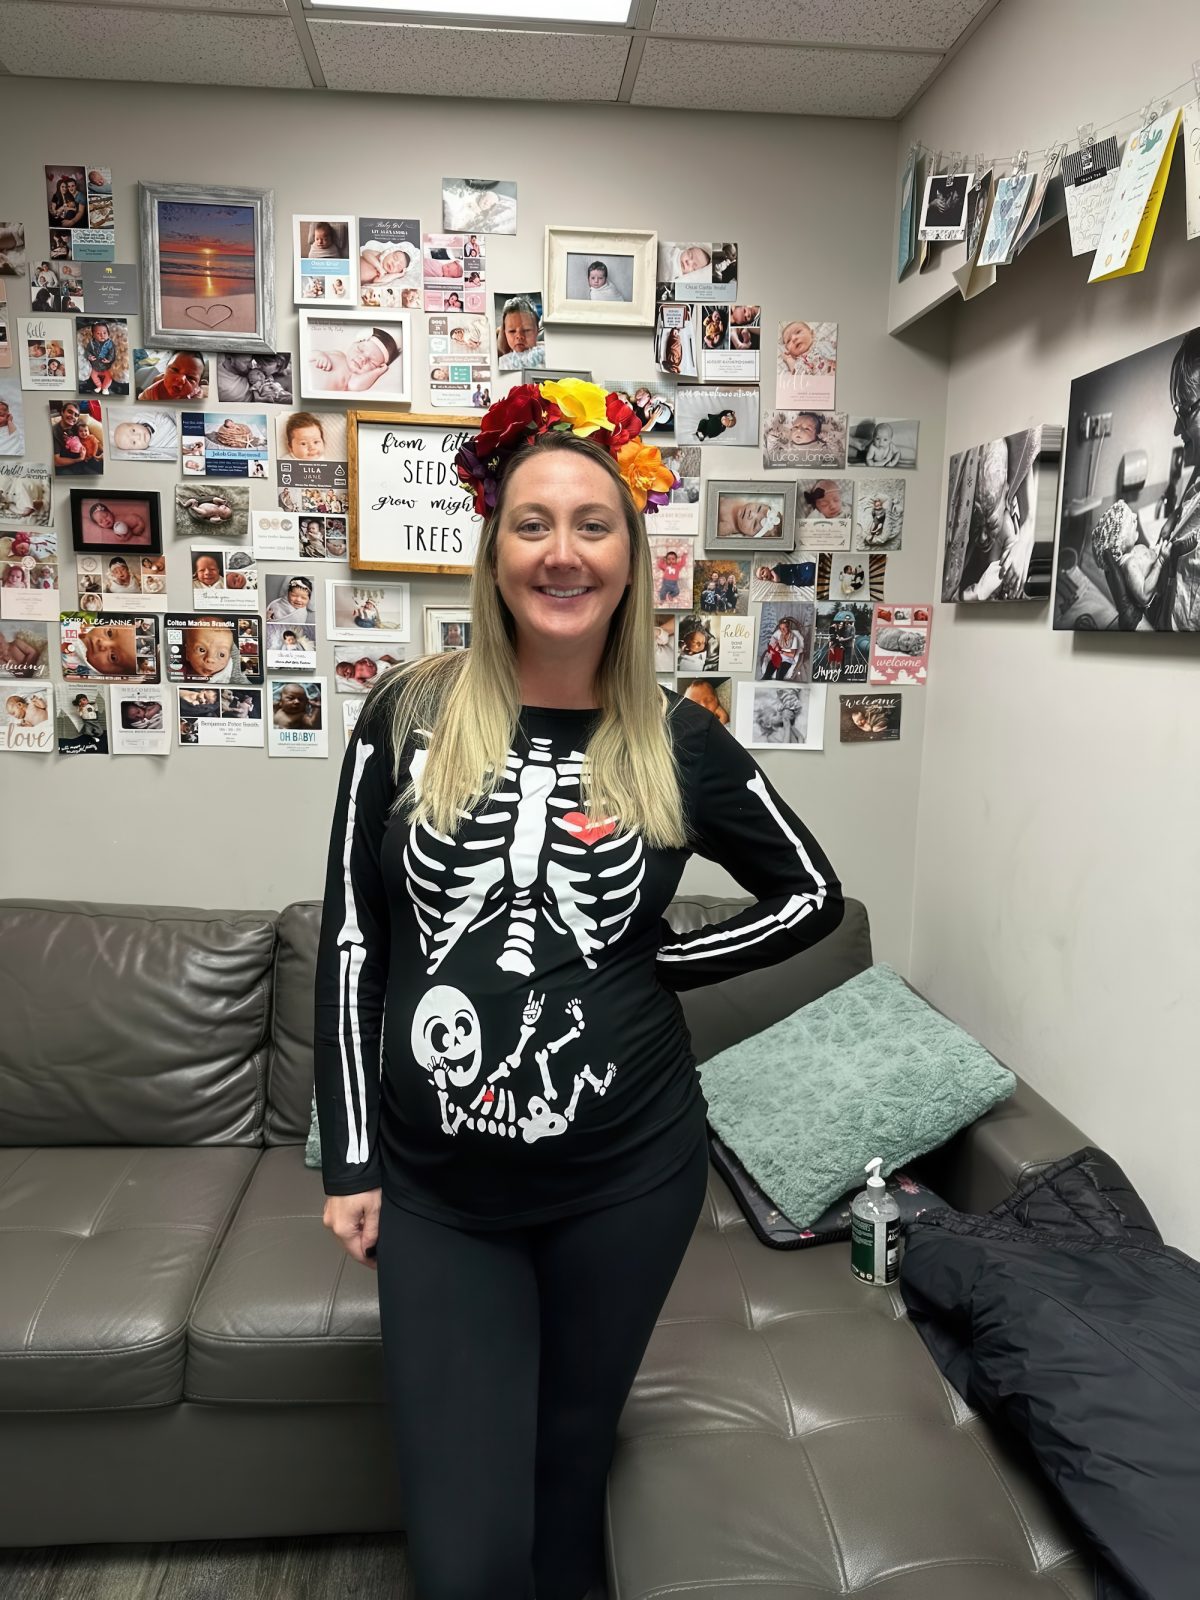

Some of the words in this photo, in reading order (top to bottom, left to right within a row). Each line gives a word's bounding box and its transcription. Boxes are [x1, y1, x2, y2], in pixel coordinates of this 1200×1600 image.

[26, 321, 47, 338] hello
[381, 432, 426, 454] from
[441, 431, 475, 453] litt
[772, 453, 800, 462] Lucas
[801, 450, 835, 462] James
[403, 459, 459, 486] SEEDS
[371, 495, 417, 511] grow
[430, 496, 482, 522] migh
[403, 524, 463, 553] TREES
[89, 618, 132, 626] LEE-ANNE
[721, 623, 750, 638] hello
[0, 659, 46, 677] ducing
[876, 655, 922, 667] welcome
[844, 664, 867, 675] 2020!
[844, 696, 898, 708] welcome
[7, 722, 54, 749] love
[279, 732, 291, 741] OH
[292, 732, 316, 742] BABY!
